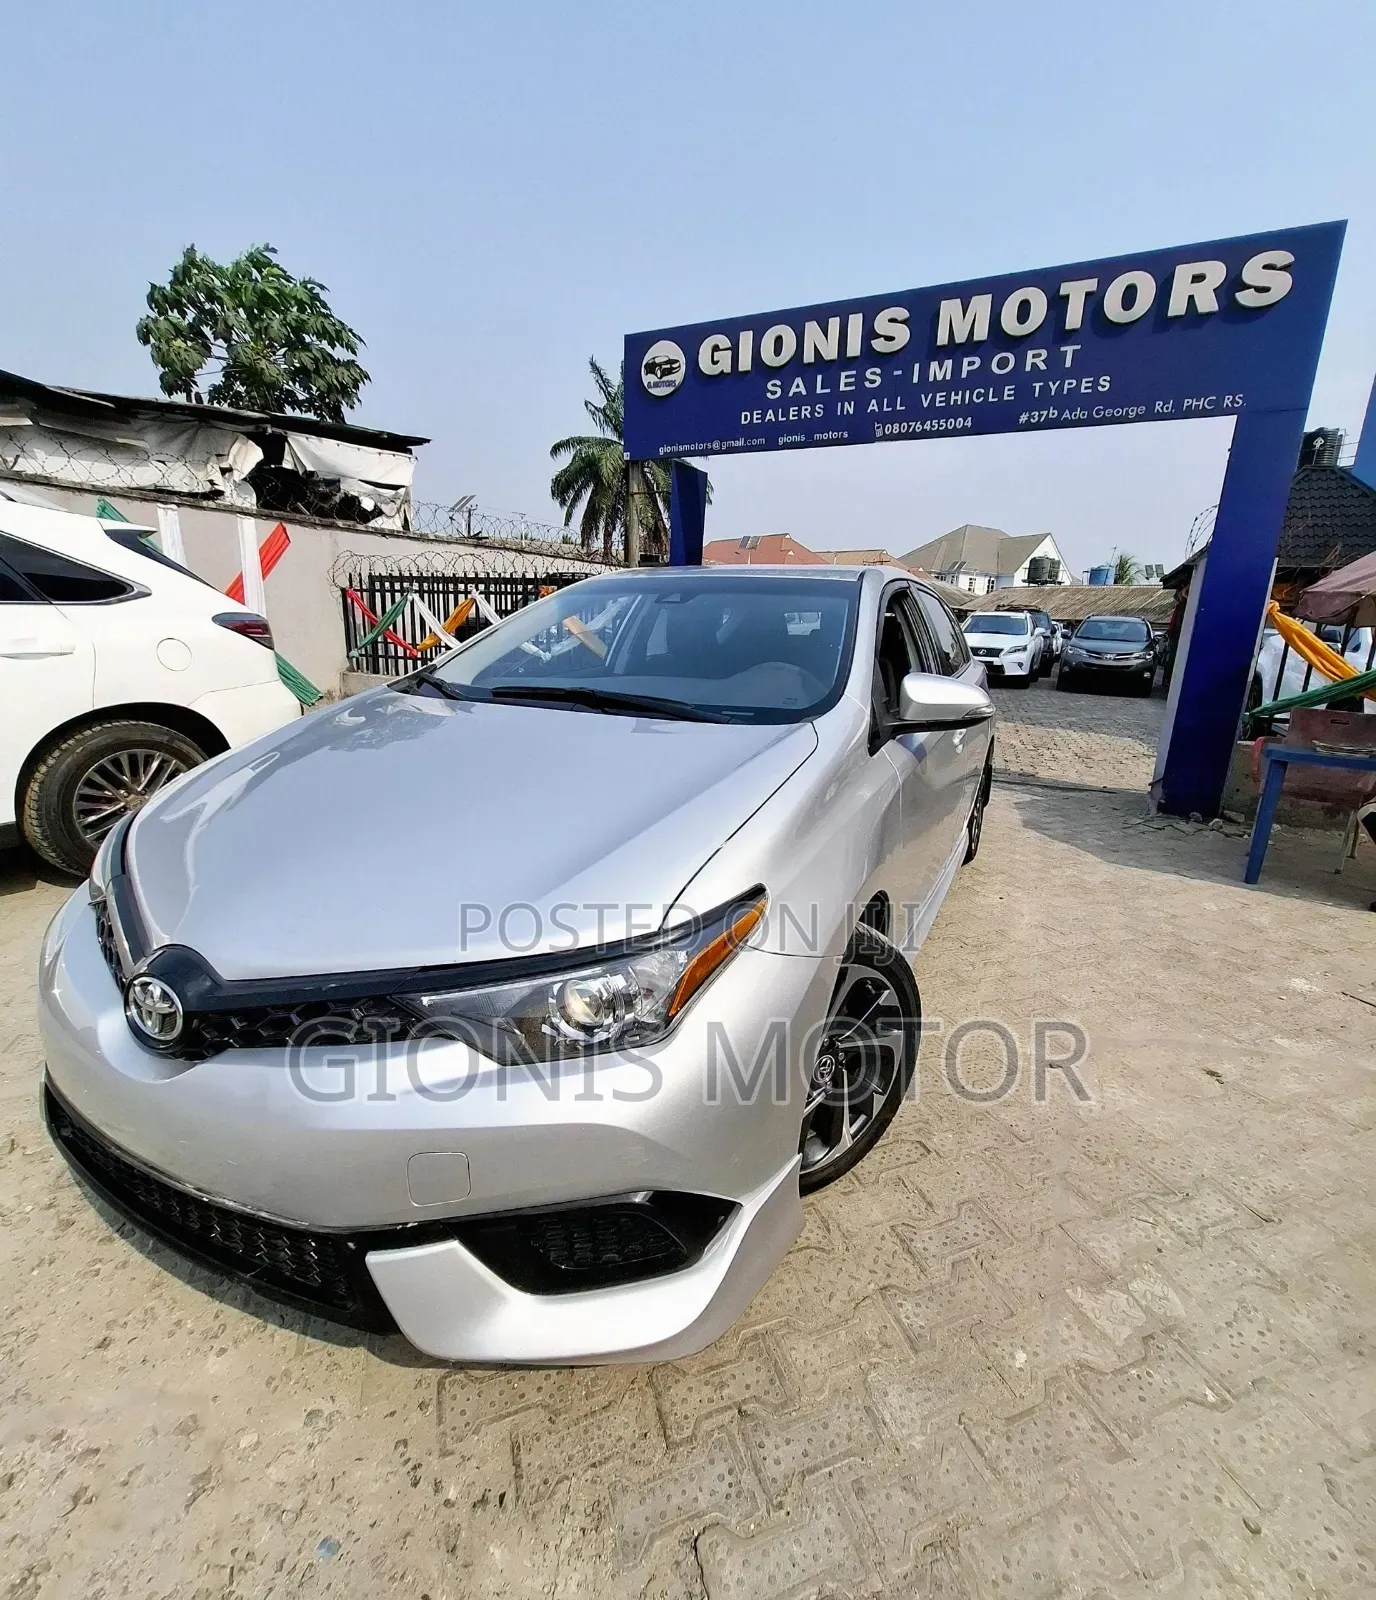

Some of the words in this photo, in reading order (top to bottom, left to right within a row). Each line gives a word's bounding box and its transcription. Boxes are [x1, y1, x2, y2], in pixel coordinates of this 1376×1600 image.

[698, 306, 911, 376] GIONIS
[935, 249, 1296, 347] MOTORS
[741, 404, 825, 425] DEALERS
[837, 401, 855, 416] IN
[867, 397, 906, 413] ALL
[921, 385, 1016, 409] VEHICLE
[1032, 375, 1112, 398] TYPES
[1018, 406, 1058, 424] #37b
[1061, 407, 1088, 421] Ada
[1092, 405, 1146, 419] George
[1182, 396, 1217, 412] PHC
[1223, 393, 1247, 408] RS.
[884, 416, 973, 436] 08076455004
[659, 437, 766, 456] gionismotors@gmail.com
